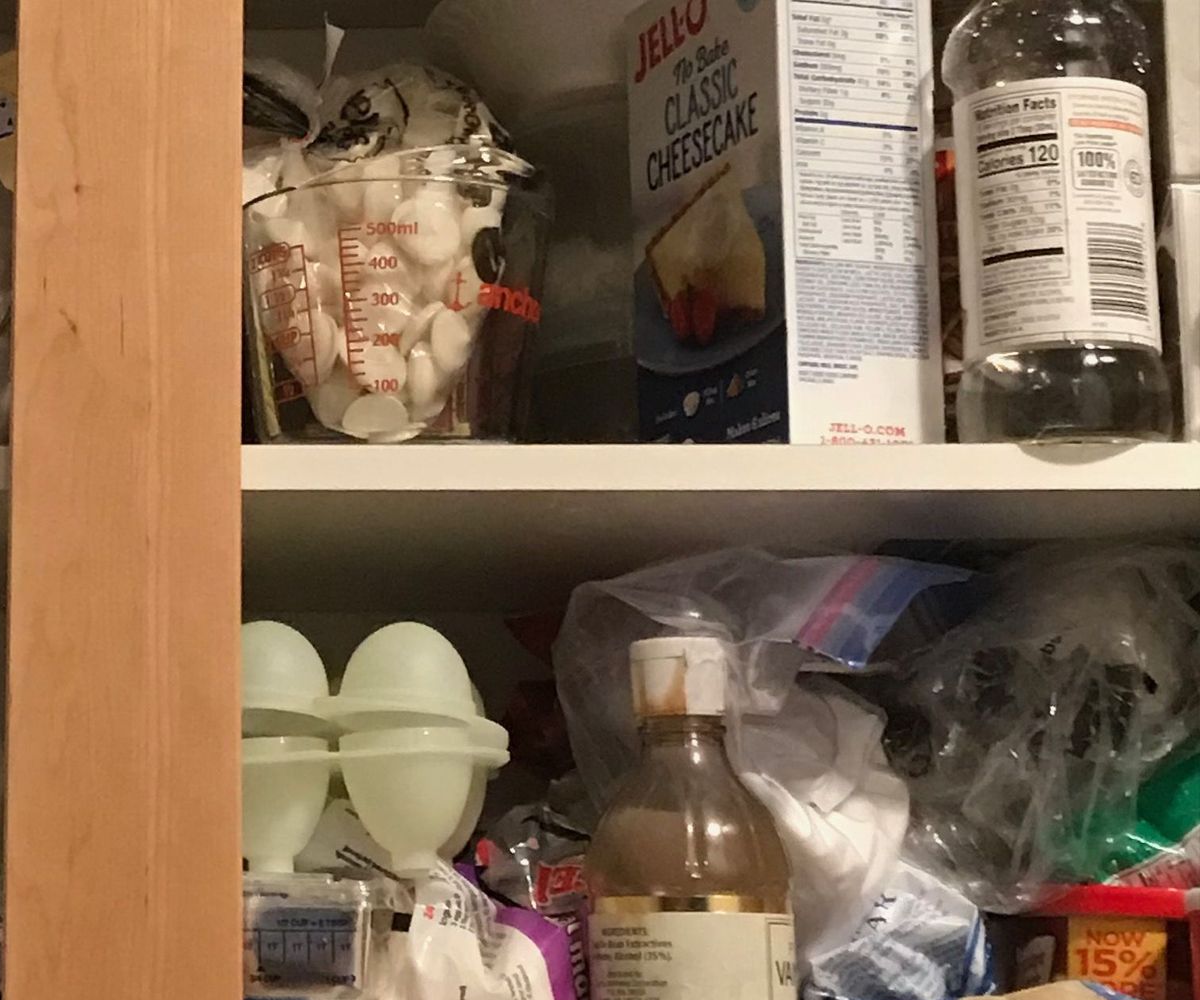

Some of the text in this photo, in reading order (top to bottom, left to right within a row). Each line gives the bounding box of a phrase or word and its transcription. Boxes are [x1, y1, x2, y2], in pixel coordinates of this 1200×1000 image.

[695, 36, 729, 74] Bake
[664, 57, 738, 136] CLASSIC
[1022, 97, 1057, 112] Facts
[647, 91, 759, 191] CHEESECAKE
[1028, 143, 1060, 163] 120
[1077, 150, 1117, 170] 100%
[365, 221, 419, 235] 500ml
[368, 255, 398, 270] 400
[371, 293, 399, 307] 300
[371, 332, 400, 347] 200
[372, 378, 399, 392] 100
[828, 422, 907, 437] JELL-O.COM
[1085, 928, 1146, 948] NOW
[1074, 948, 1157, 979] 15%
